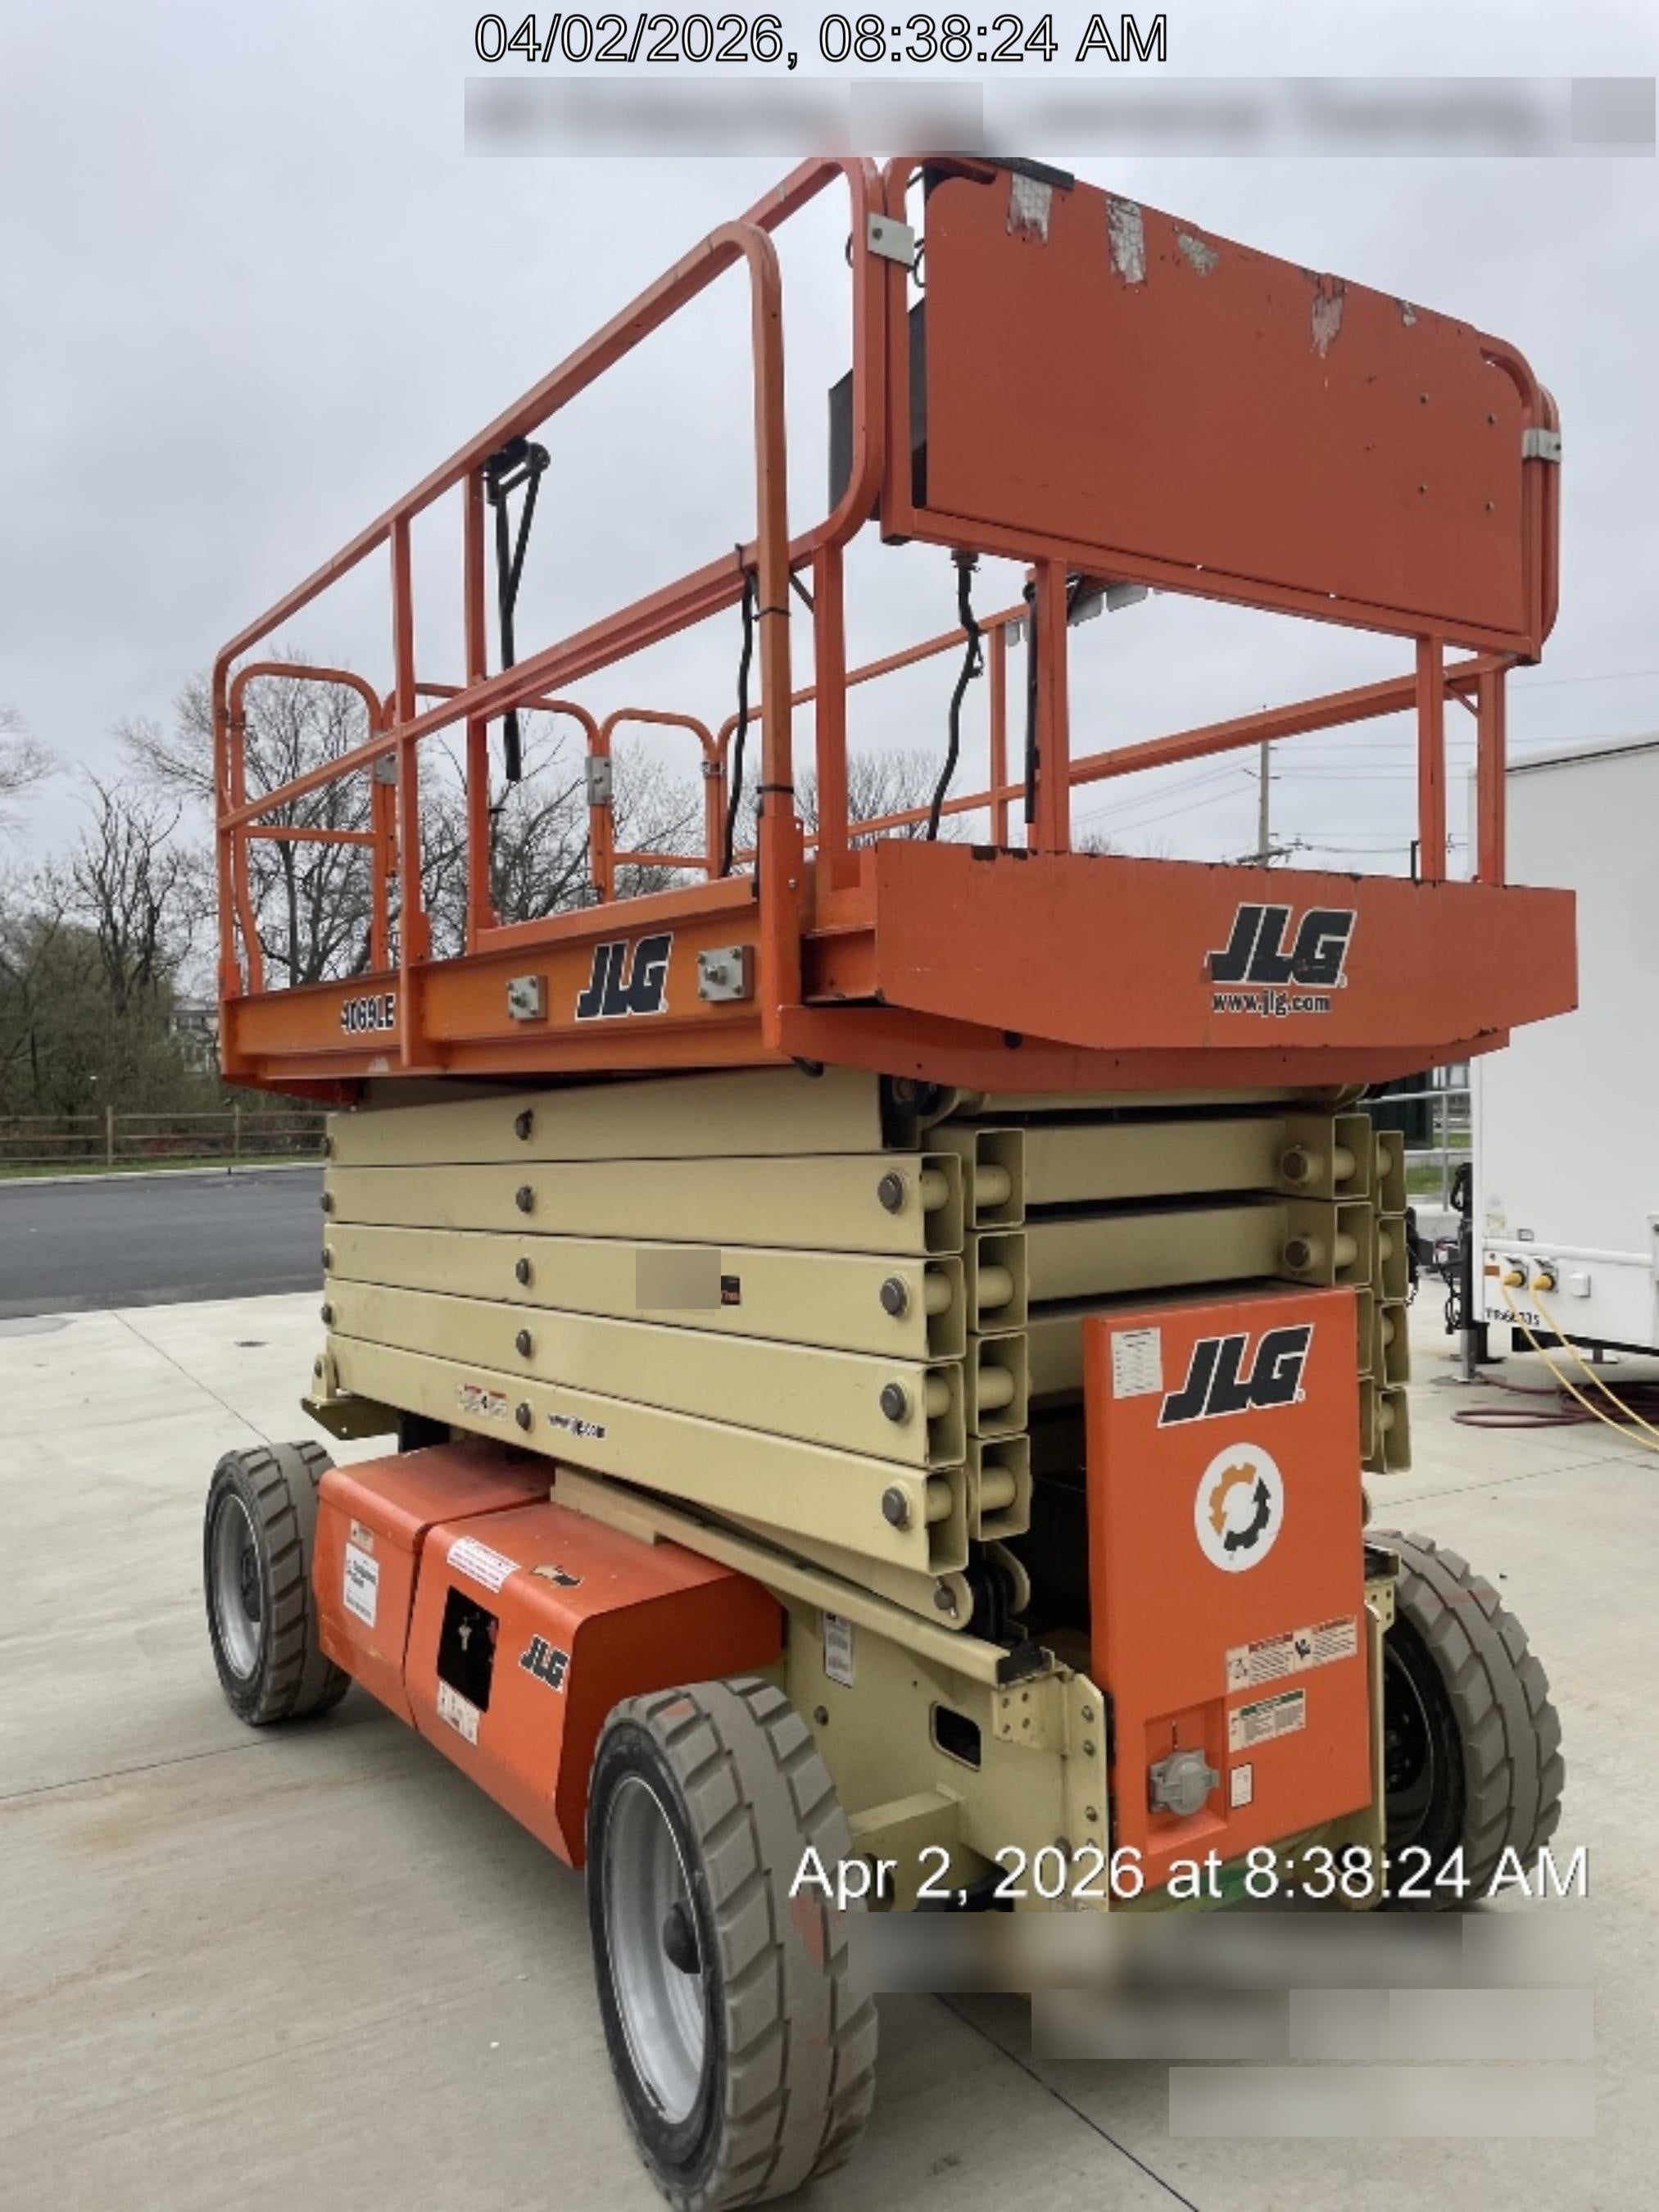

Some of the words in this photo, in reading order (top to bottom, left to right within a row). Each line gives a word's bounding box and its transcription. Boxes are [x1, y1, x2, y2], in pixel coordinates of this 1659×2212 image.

[575, 932, 673, 1022] JLG
[1204, 902, 1357, 988] JLG
[1213, 989, 1331, 1018] www.jlg.com
[1158, 1322, 1315, 1428] JLG
[518, 1633, 570, 1694] JLG
